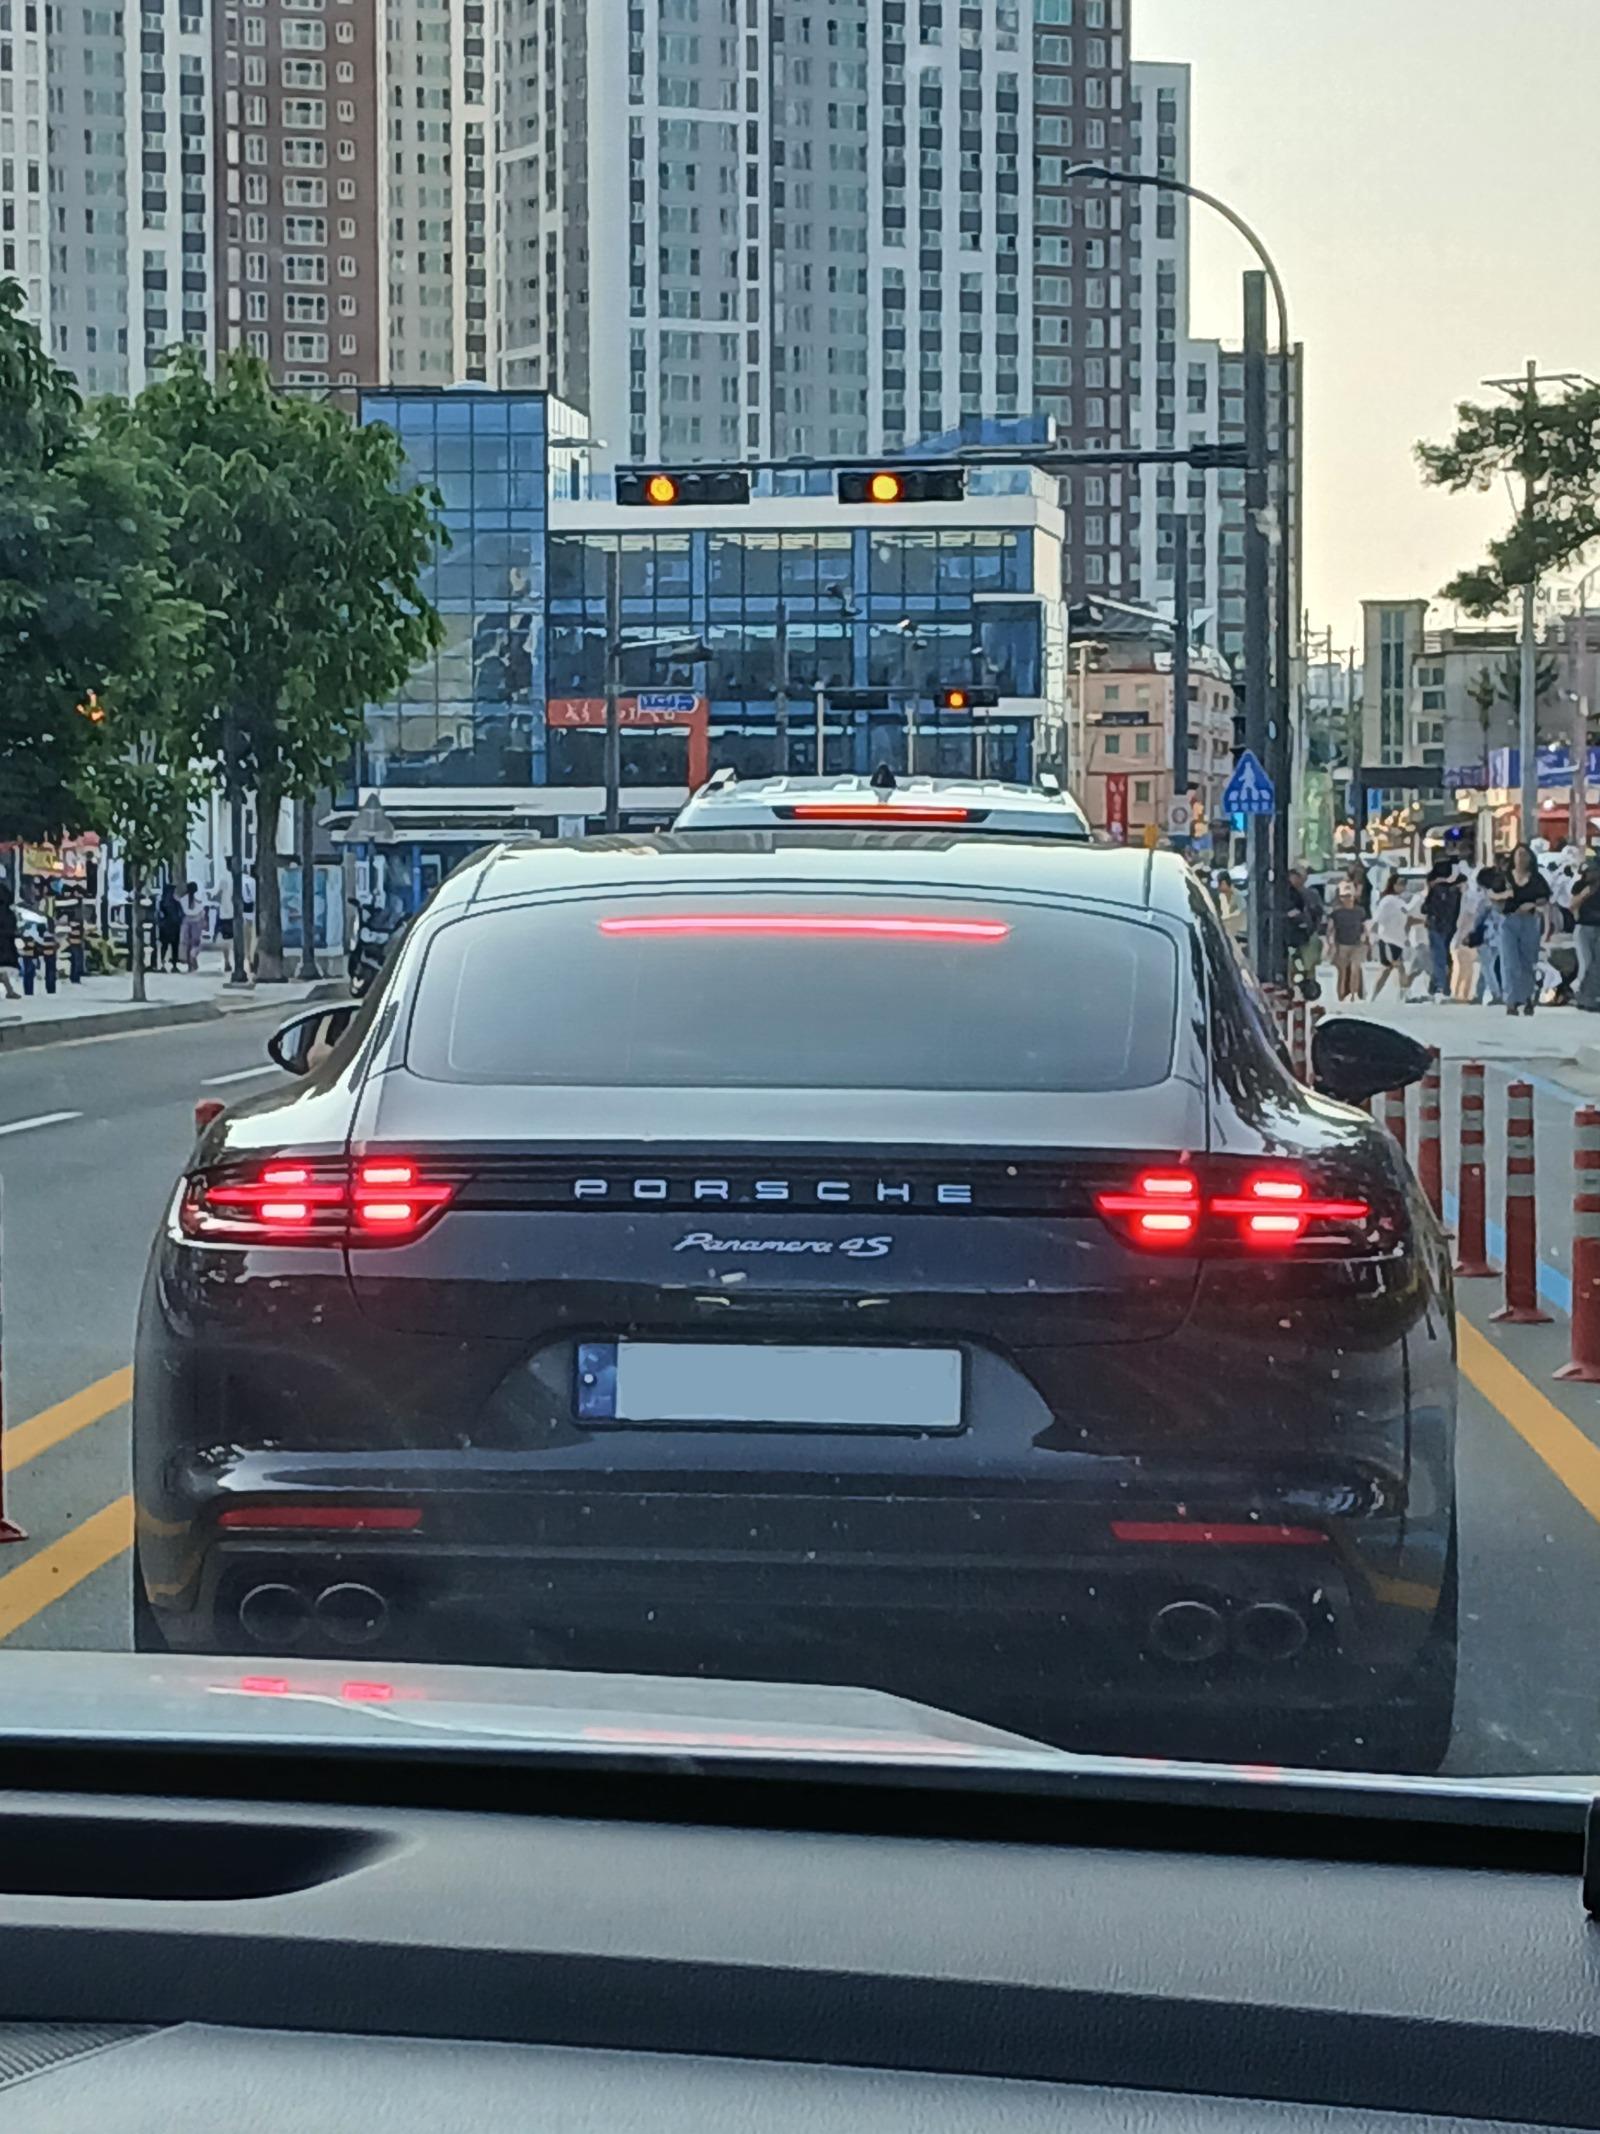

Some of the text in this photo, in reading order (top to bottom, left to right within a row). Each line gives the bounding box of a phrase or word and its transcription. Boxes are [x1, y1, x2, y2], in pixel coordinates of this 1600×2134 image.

[574, 1178, 972, 1204] PORSCHE
[673, 1232, 893, 1257] Panamera 4S
